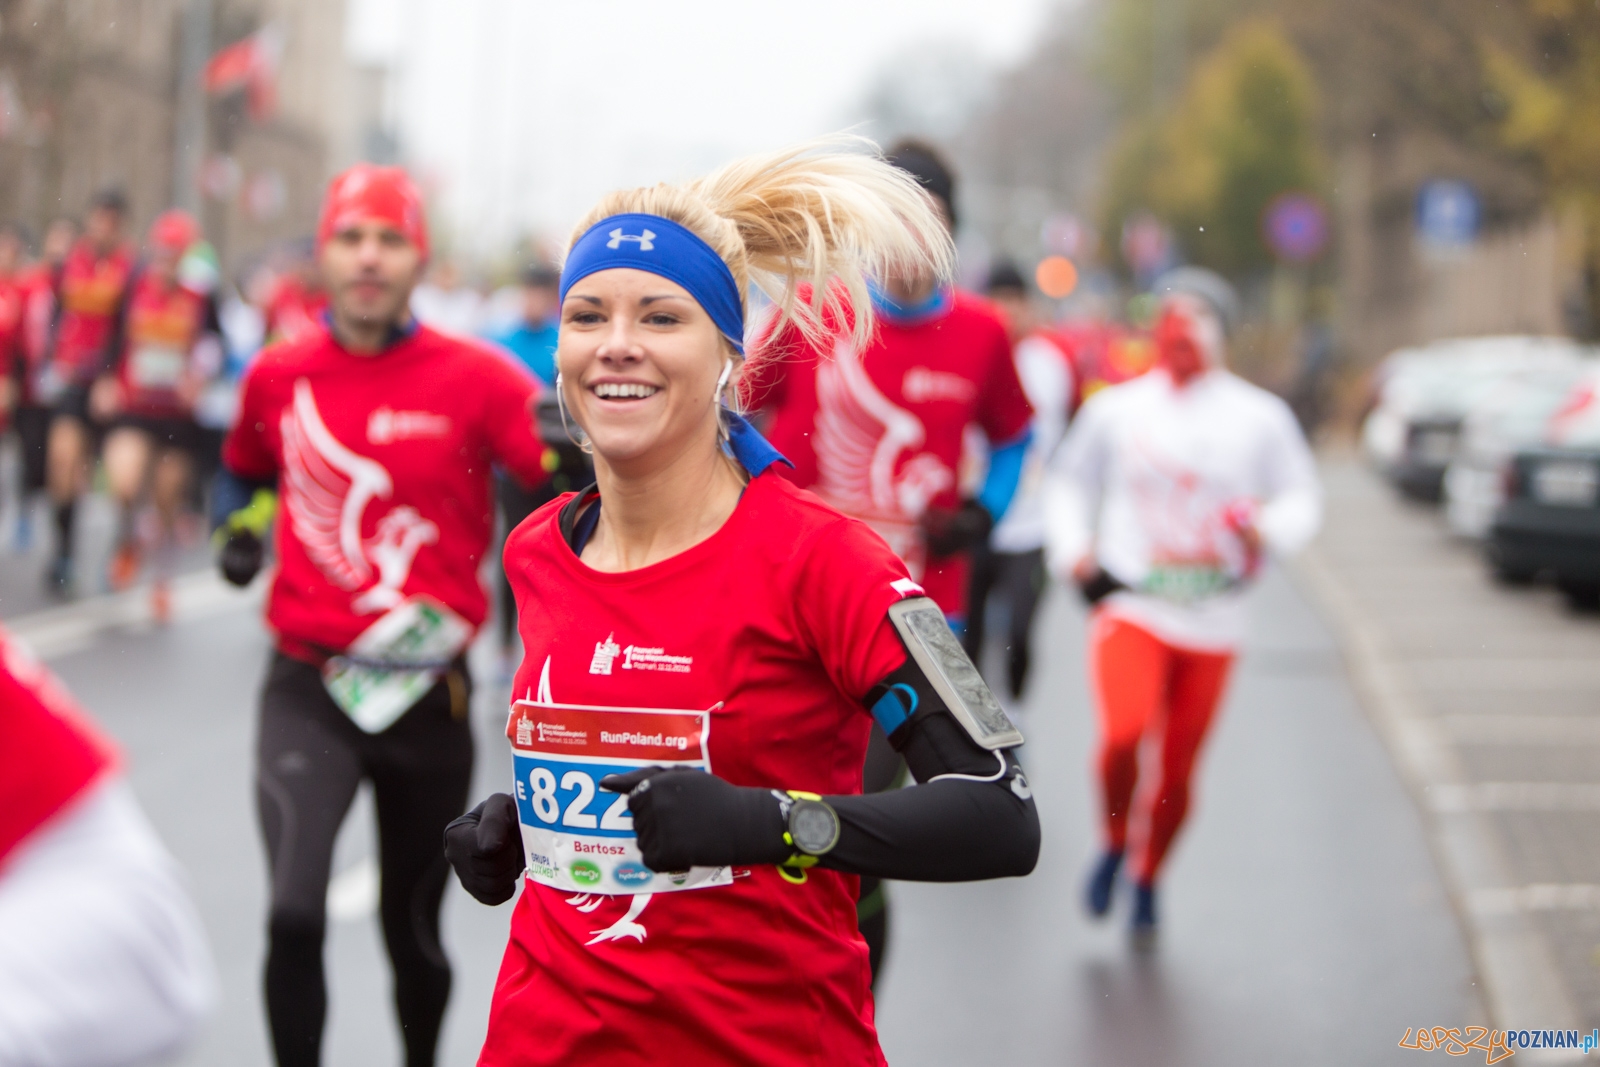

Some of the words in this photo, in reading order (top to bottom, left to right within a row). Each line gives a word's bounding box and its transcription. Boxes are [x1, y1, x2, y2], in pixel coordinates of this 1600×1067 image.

[600, 731, 688, 750] RunPoland.org
[573, 841, 625, 855] Bartosz
[531, 852, 550, 866] GRUPA
